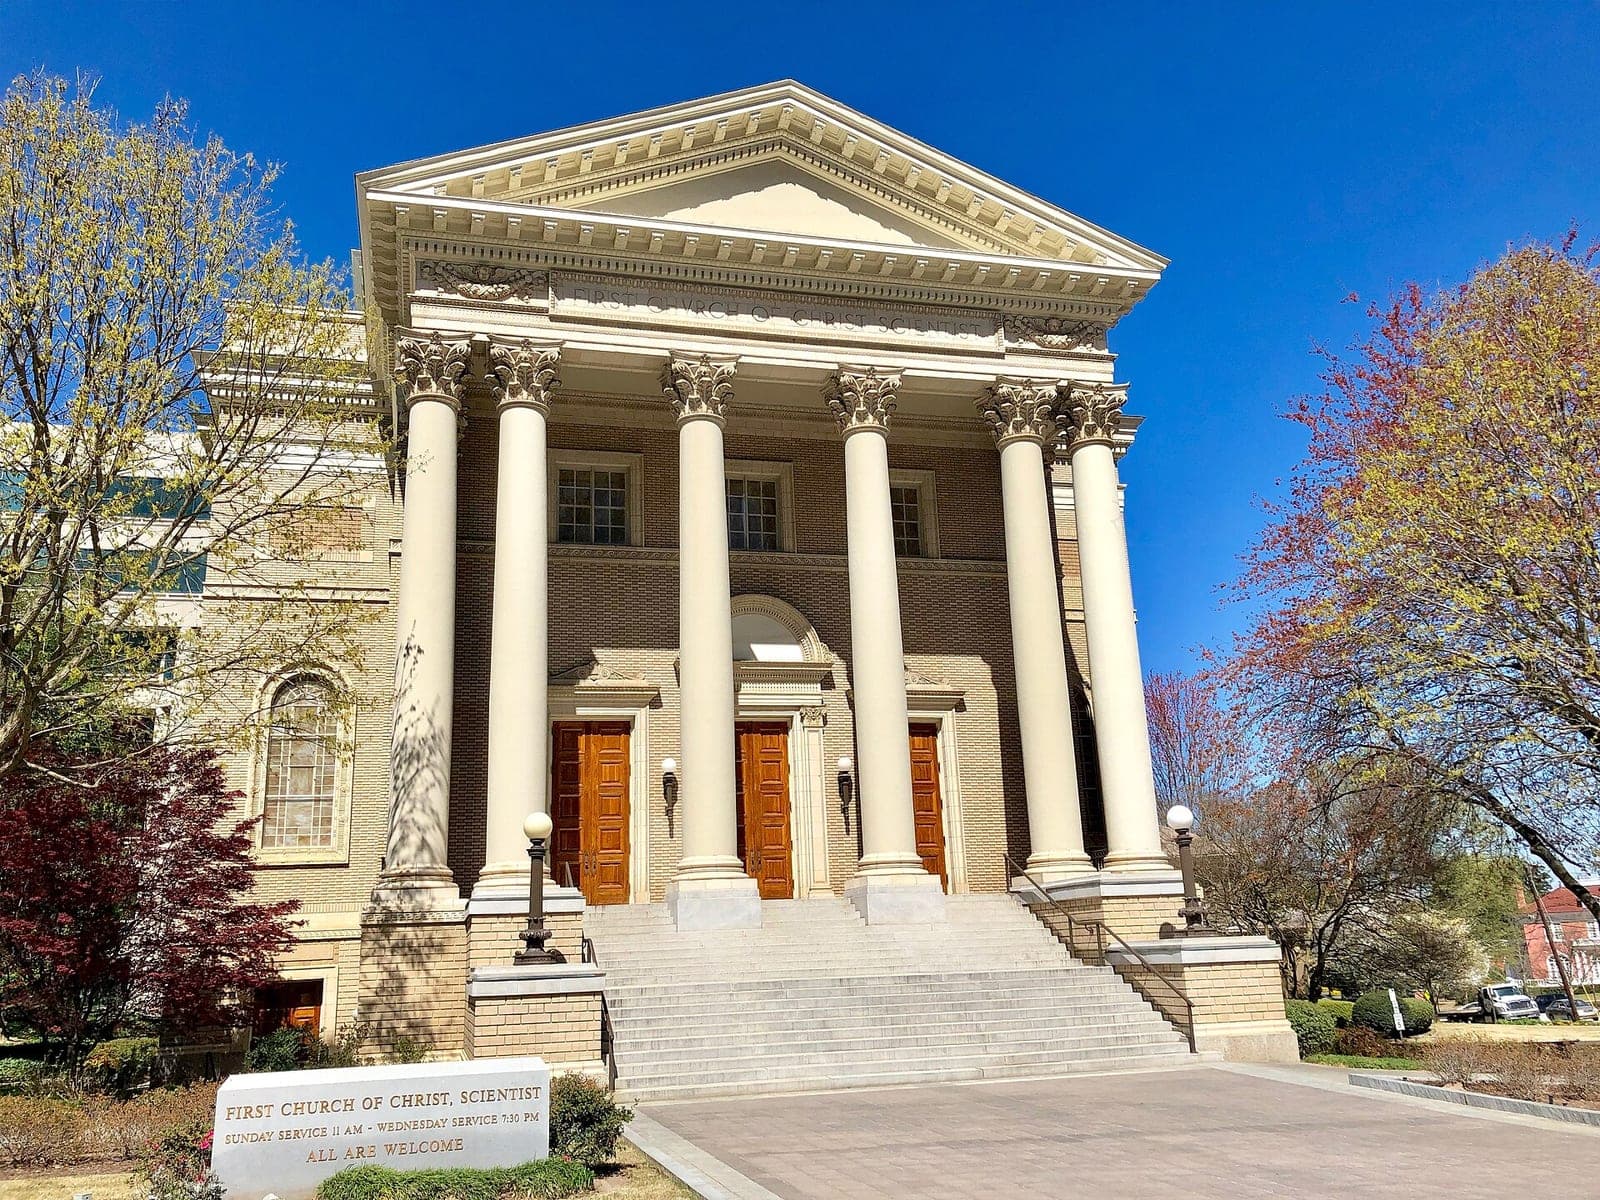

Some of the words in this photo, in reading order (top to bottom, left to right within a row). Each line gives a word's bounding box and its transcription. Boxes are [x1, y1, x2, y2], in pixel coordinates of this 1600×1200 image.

[225, 1104, 274, 1120] FIRST
[281, 1098, 355, 1117] CHURCH
[362, 1096, 384, 1111] OF
[390, 1092, 453, 1108] CHRIST,
[460, 1086, 542, 1104] SCIENTIST
[225, 1131, 274, 1145] SUNDAY
[278, 1127, 328, 1141] SERVICE
[332, 1126, 340, 1136] 11
[344, 1124, 363, 1135] AM
[377, 1118, 448, 1132] WEDNESDAY
[452, 1114, 498, 1127] SERVICE
[501, 1113, 520, 1124] 7:30
[523, 1112, 540, 1122] PM
[306, 1148, 338, 1163] ALL
[344, 1145, 377, 1160] ARE
[384, 1138, 464, 1156] WELCOME
